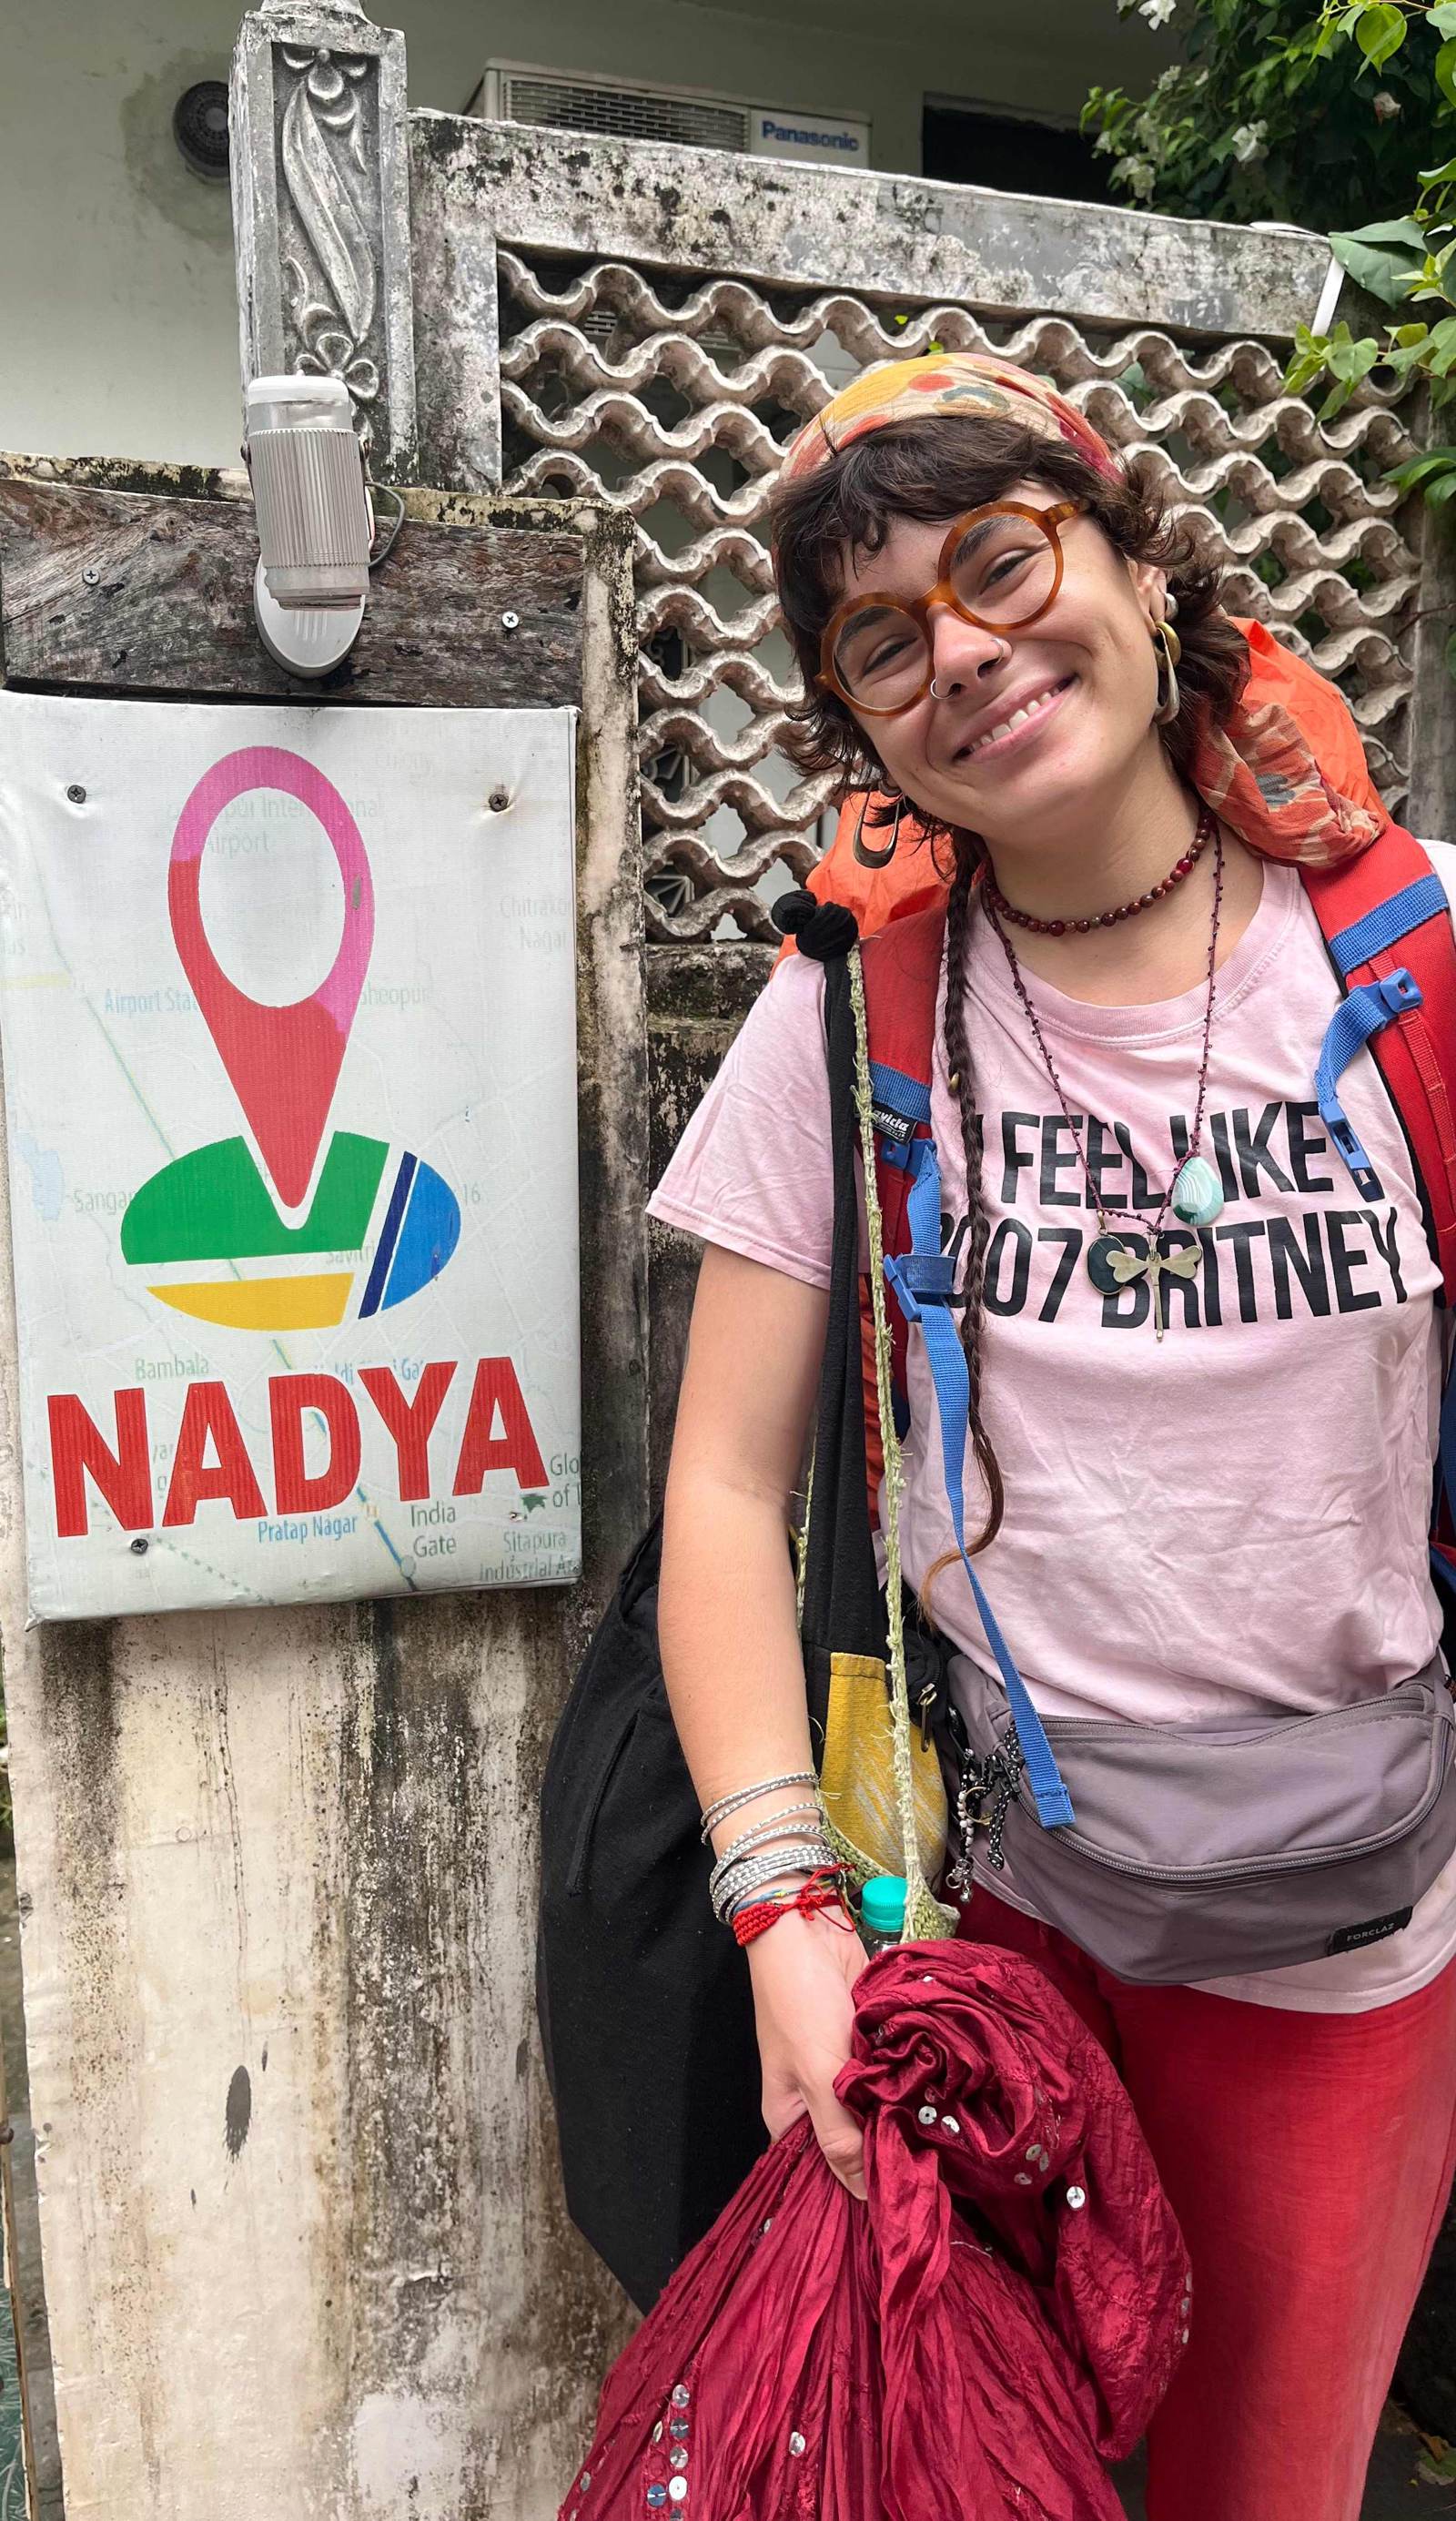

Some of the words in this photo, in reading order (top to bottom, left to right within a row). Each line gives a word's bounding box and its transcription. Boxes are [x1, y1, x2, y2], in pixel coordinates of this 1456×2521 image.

[761, 119, 860, 152] Panasonic
[104, 987, 162, 1018] Airport
[1001, 1110, 1167, 1210] FEEL
[1100, 1206, 1408, 1330] BRITNEY
[135, 1351, 210, 1381] Bambala
[46, 1355, 551, 1538] NADYA
[552, 1483, 571, 1508] of
[410, 1501, 457, 1528] India
[257, 1519, 308, 1545] Pratap
[312, 1515, 359, 1542] Nagar
[503, 1530, 567, 1554] Sitapura
[412, 1534, 457, 1558] Gate
[1346, 1921, 1396, 1942] FORCLAZ
